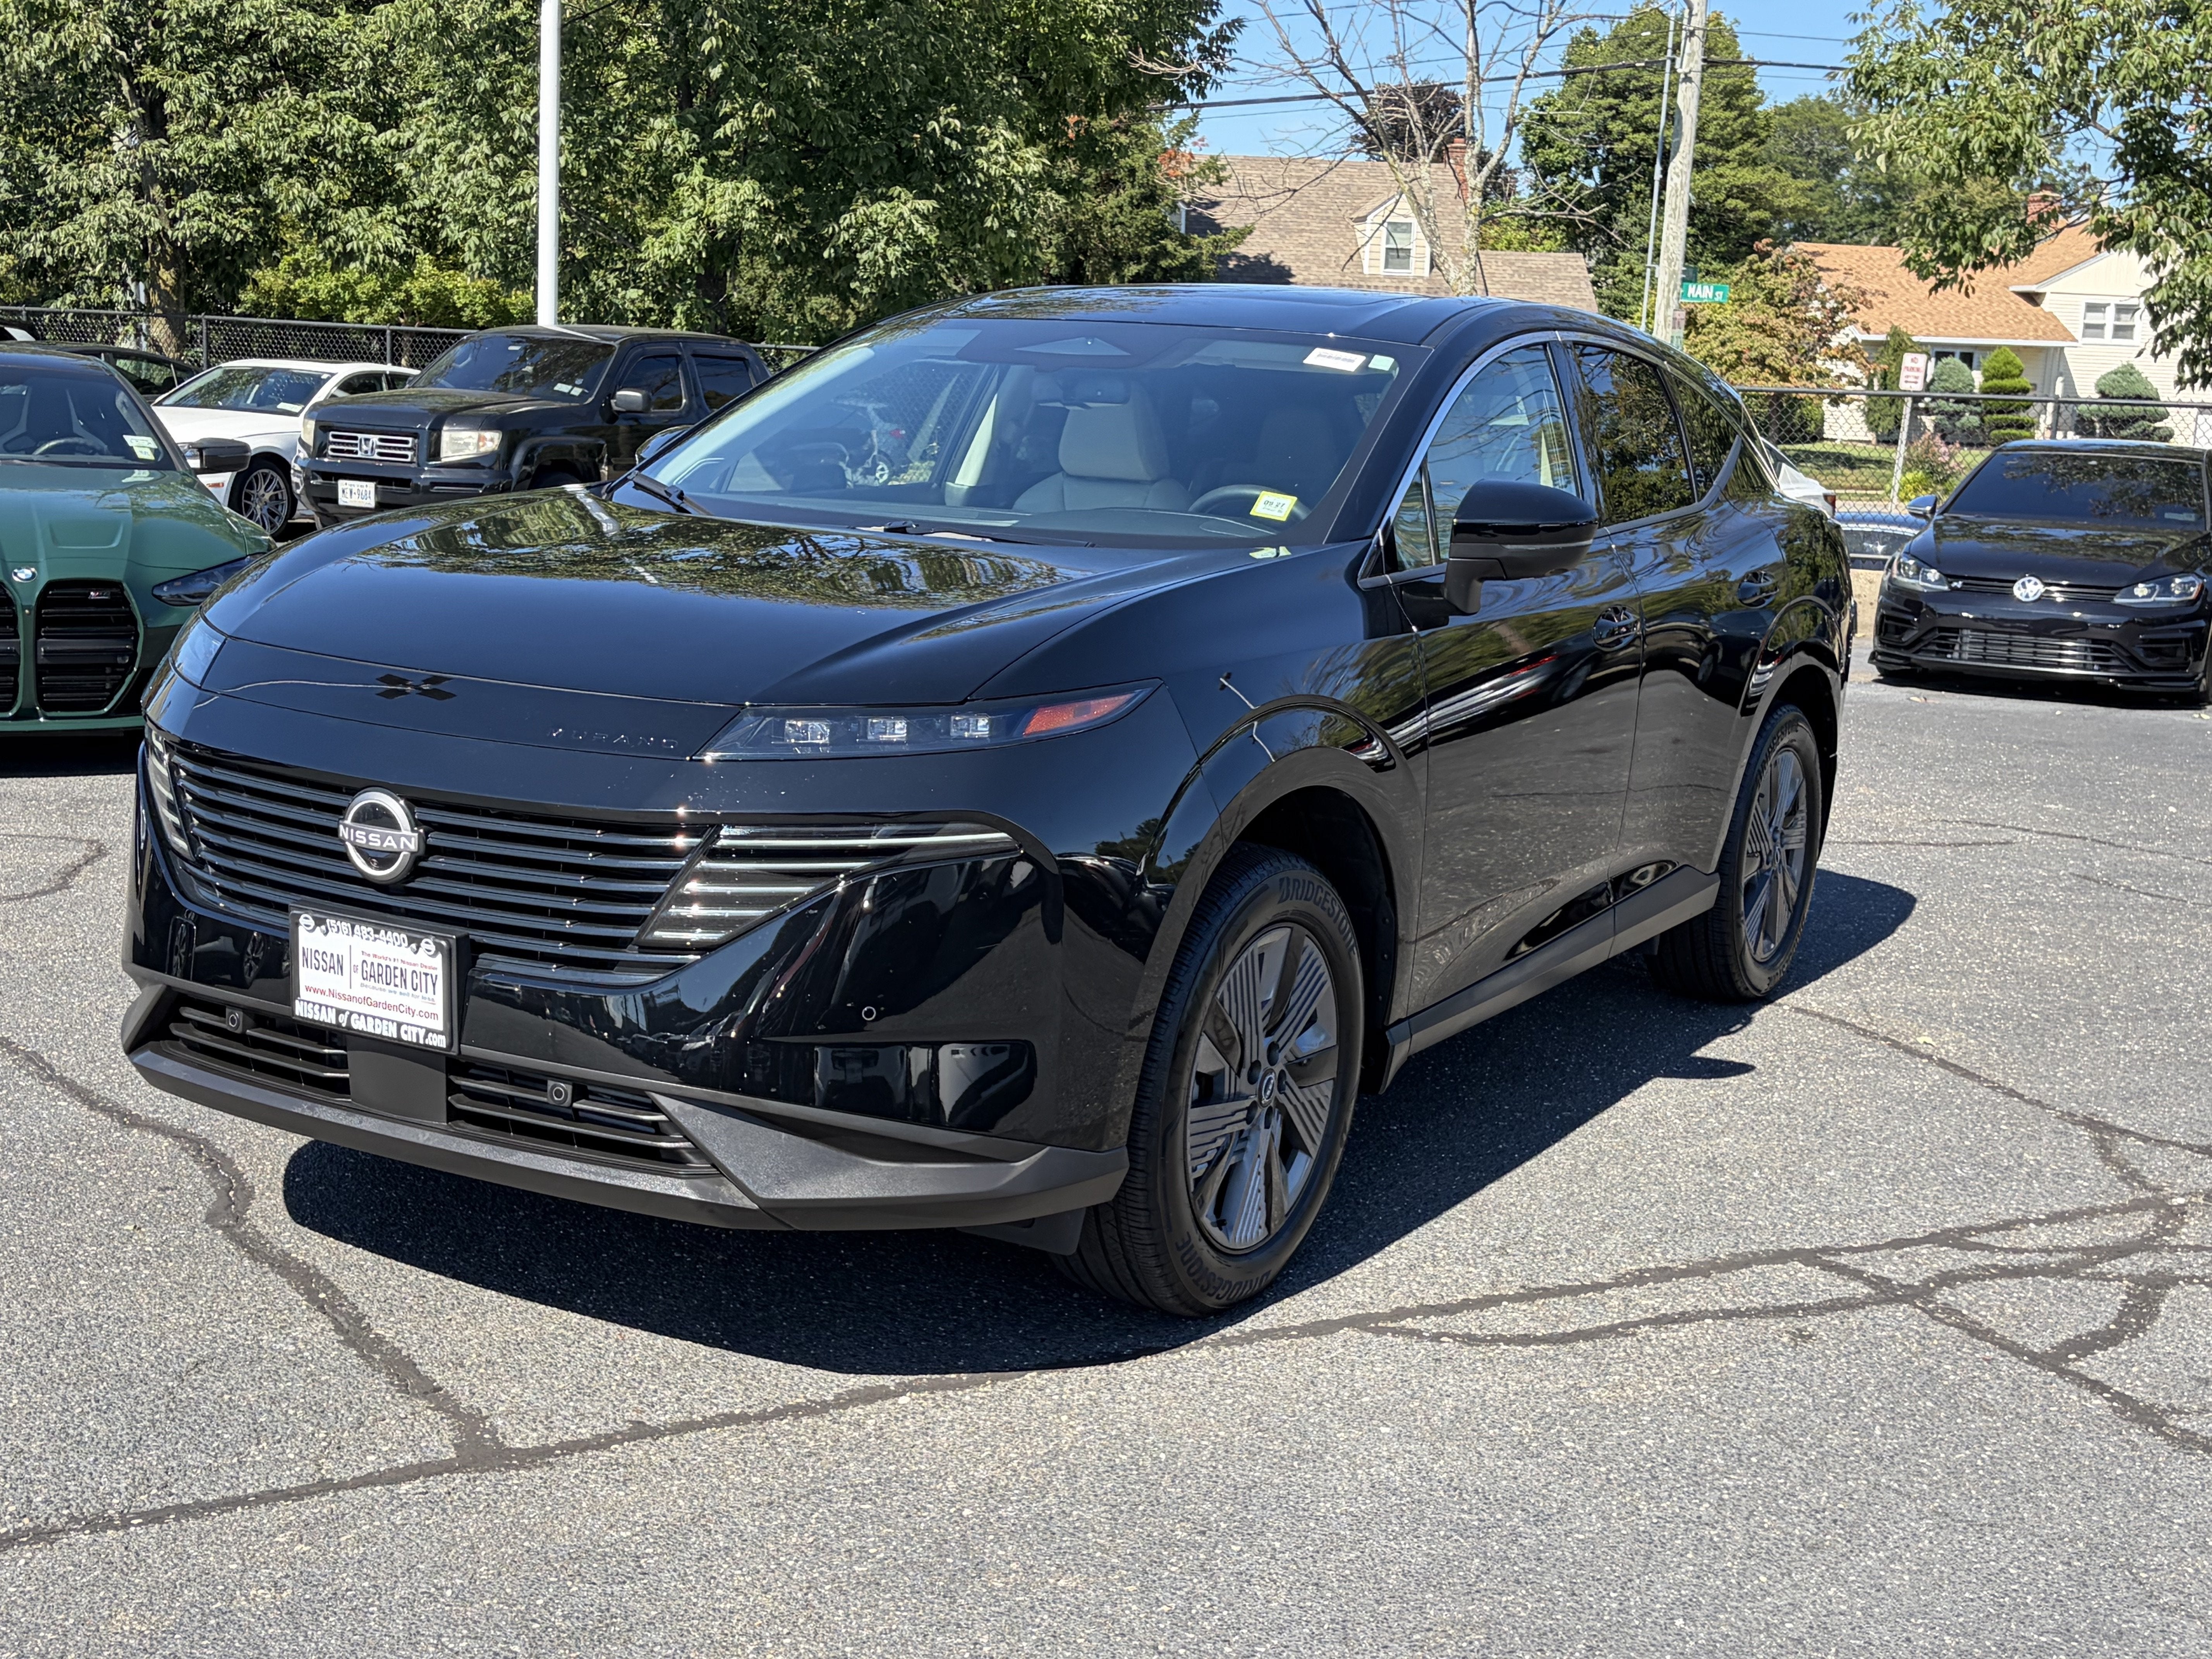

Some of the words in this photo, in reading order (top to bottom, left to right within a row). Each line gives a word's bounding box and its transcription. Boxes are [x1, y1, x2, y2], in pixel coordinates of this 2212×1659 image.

[1688, 284, 1714, 299] MAIN
[339, 824, 415, 849] NISSAN
[326, 919, 352, 937] (516)
[354, 925, 408, 948] 483-4400
[1277, 876, 1355, 960] BRIDGESTONE
[302, 946, 343, 976] NISSAN
[362, 960, 407, 989] GARDEN
[411, 970, 438, 995] CITY
[305, 985, 438, 1021] www.NissanofGardenCity.com
[295, 1000, 336, 1024] NISSAN
[338, 1011, 350, 1027] of
[351, 1013, 397, 1038] GARDEN
[400, 1024, 446, 1048] CITY.com
